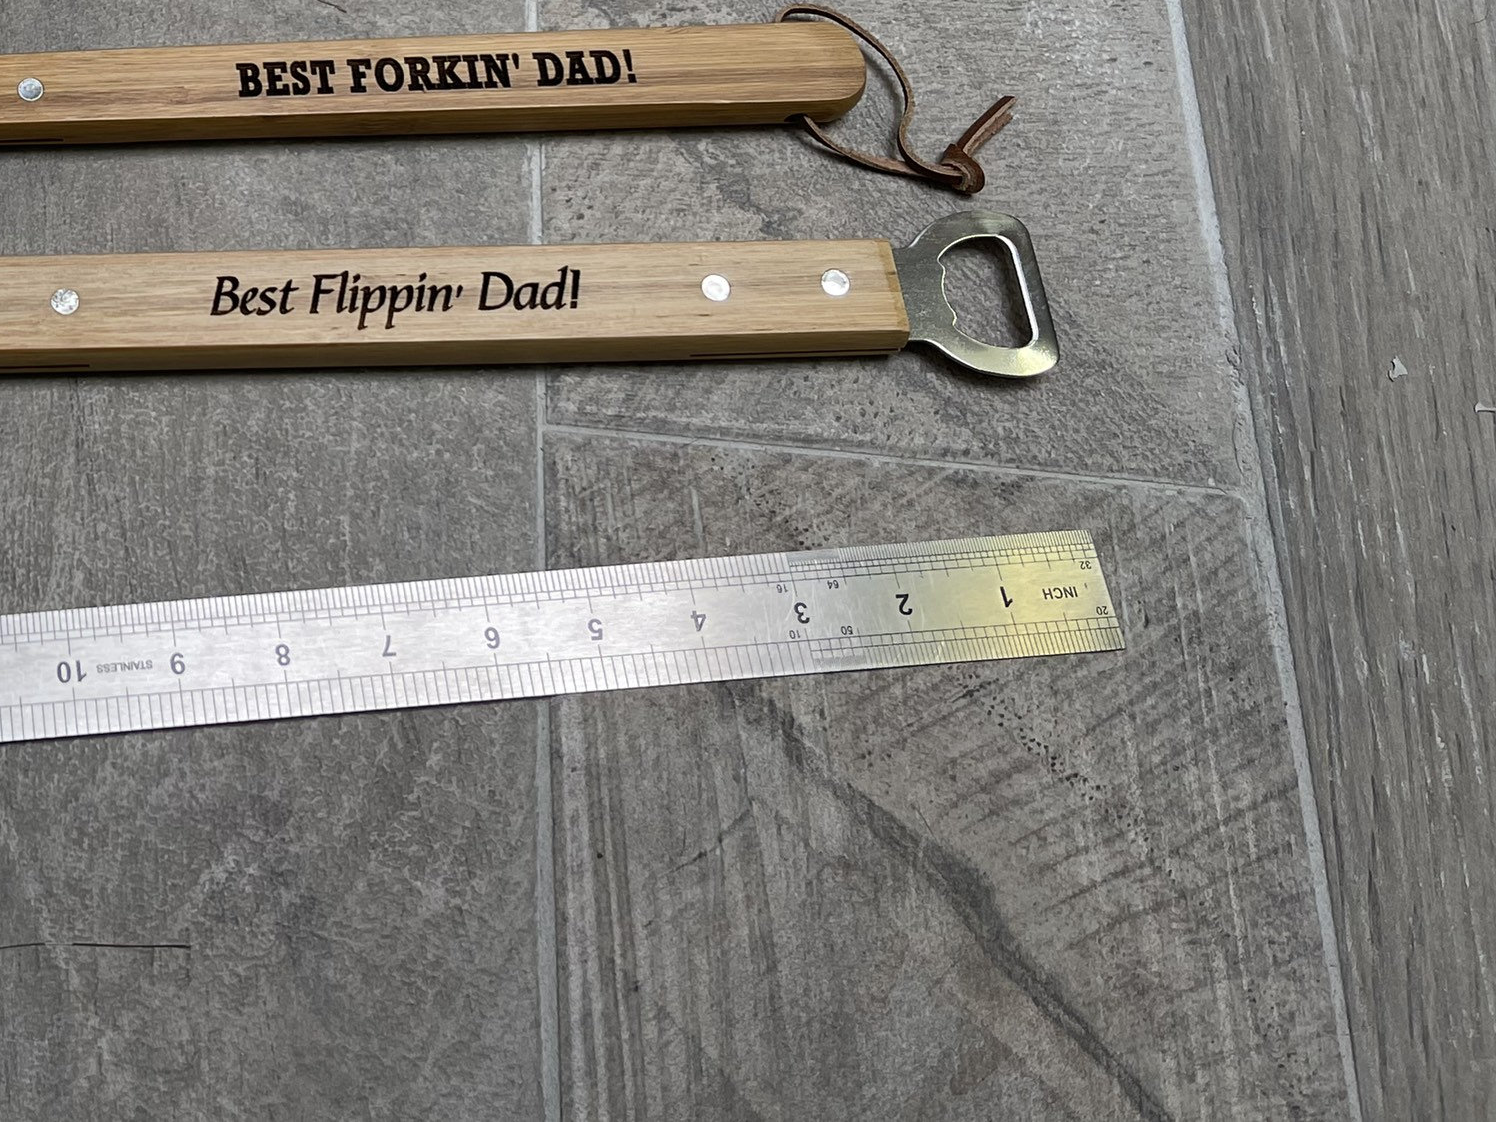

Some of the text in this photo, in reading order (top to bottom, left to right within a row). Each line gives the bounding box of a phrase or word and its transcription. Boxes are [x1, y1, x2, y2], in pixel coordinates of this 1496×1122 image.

[235, 49, 637, 98] BEST FORKIN' DAD!
[210, 265, 581, 330] Best Flippin' Dad!
[1079, 560, 1092, 570] 32
[776, 583, 789, 594] 16
[827, 579, 839, 589] 64
[1095, 605, 1109, 616] 20
[170, 585, 1078, 674] INCH 1 2 3 4 5 6 7 8 9
[789, 629, 801, 639] 10
[840, 625, 853, 635] 50
[56, 659, 87, 683] 10
[96, 658, 153, 675] STAINLESS
